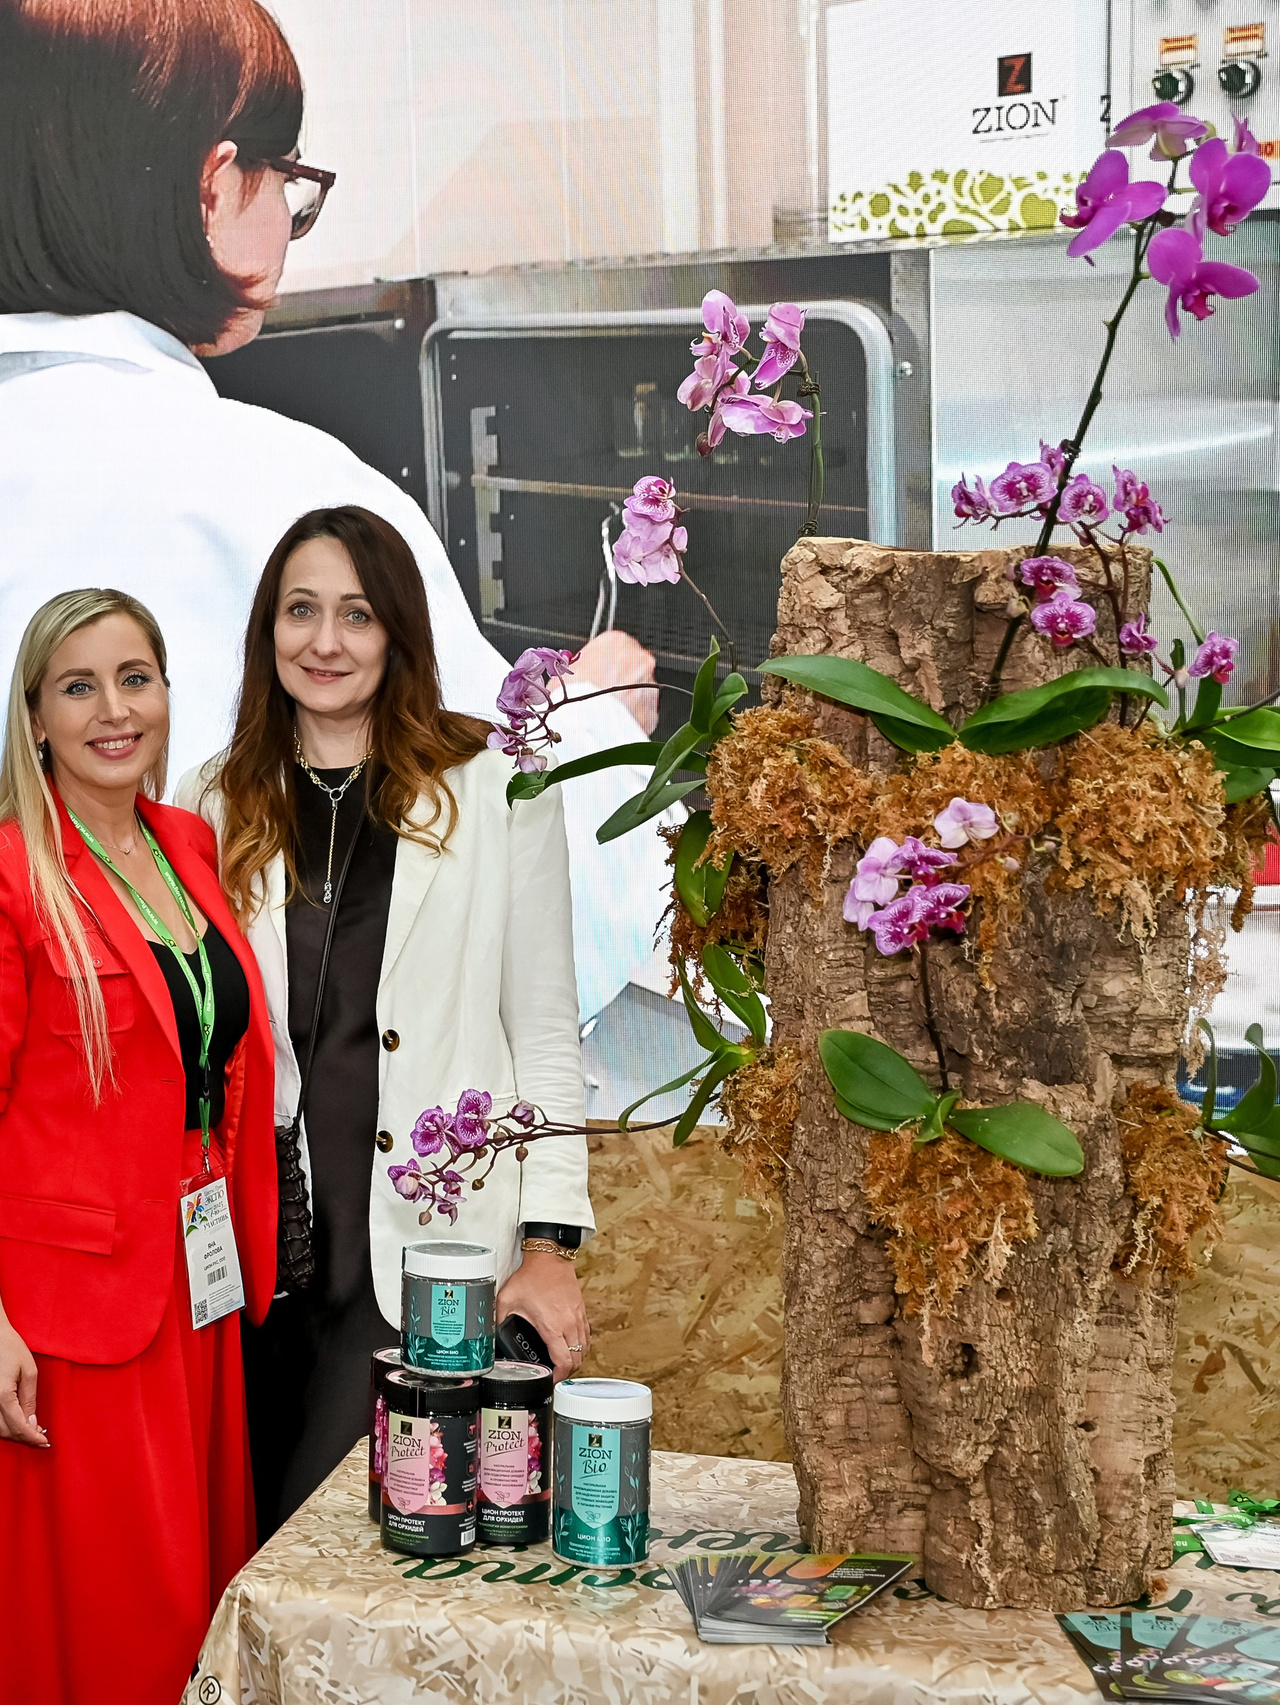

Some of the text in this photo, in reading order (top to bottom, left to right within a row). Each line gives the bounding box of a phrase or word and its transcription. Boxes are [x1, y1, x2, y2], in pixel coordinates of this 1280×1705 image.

[972, 98, 1059, 134] ZION
[204, 1190, 224, 1206] ЭКСПО
[208, 1240, 216, 1250] ЯНА
[204, 1246, 223, 1260] ФРОЛОВА
[441, 1306, 456, 1315] Bio
[392, 1434, 422, 1448] ZION
[488, 1430, 522, 1440] ZION
[390, 1445, 426, 1458] Protect
[484, 1440, 526, 1452] Protect
[578, 1448, 613, 1460] ZION
[583, 1460, 608, 1474] Bio
[482, 1508, 499, 1516] ЦИОН
[388, 1512, 426, 1526] ЦИОН ПРОТЕКТ
[398, 1522, 424, 1532] ОРХИДЕЙ
[577, 1533, 596, 1541] ЦИОН
